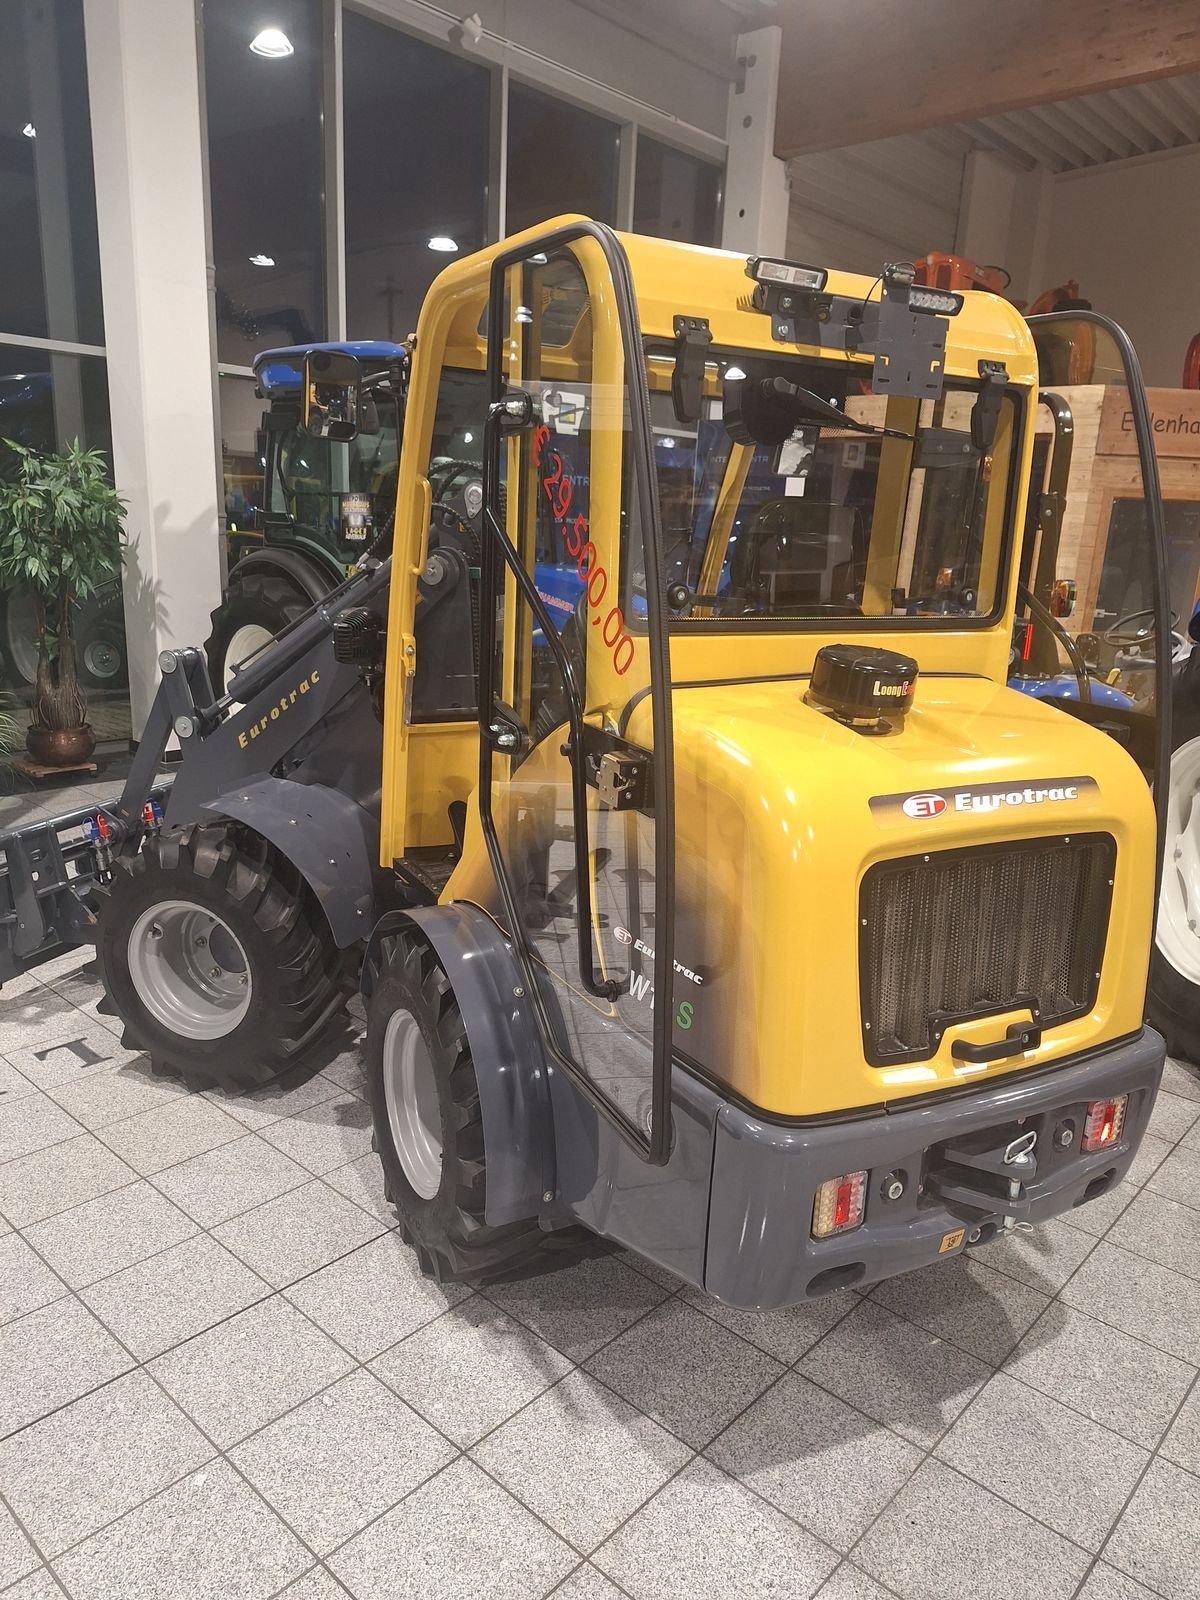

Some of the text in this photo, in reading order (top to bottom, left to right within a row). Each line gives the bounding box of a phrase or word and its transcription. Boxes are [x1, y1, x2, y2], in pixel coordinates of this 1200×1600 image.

[238, 670, 320, 749] Eurotrac
[910, 786, 1078, 818] ET Eurotrac
